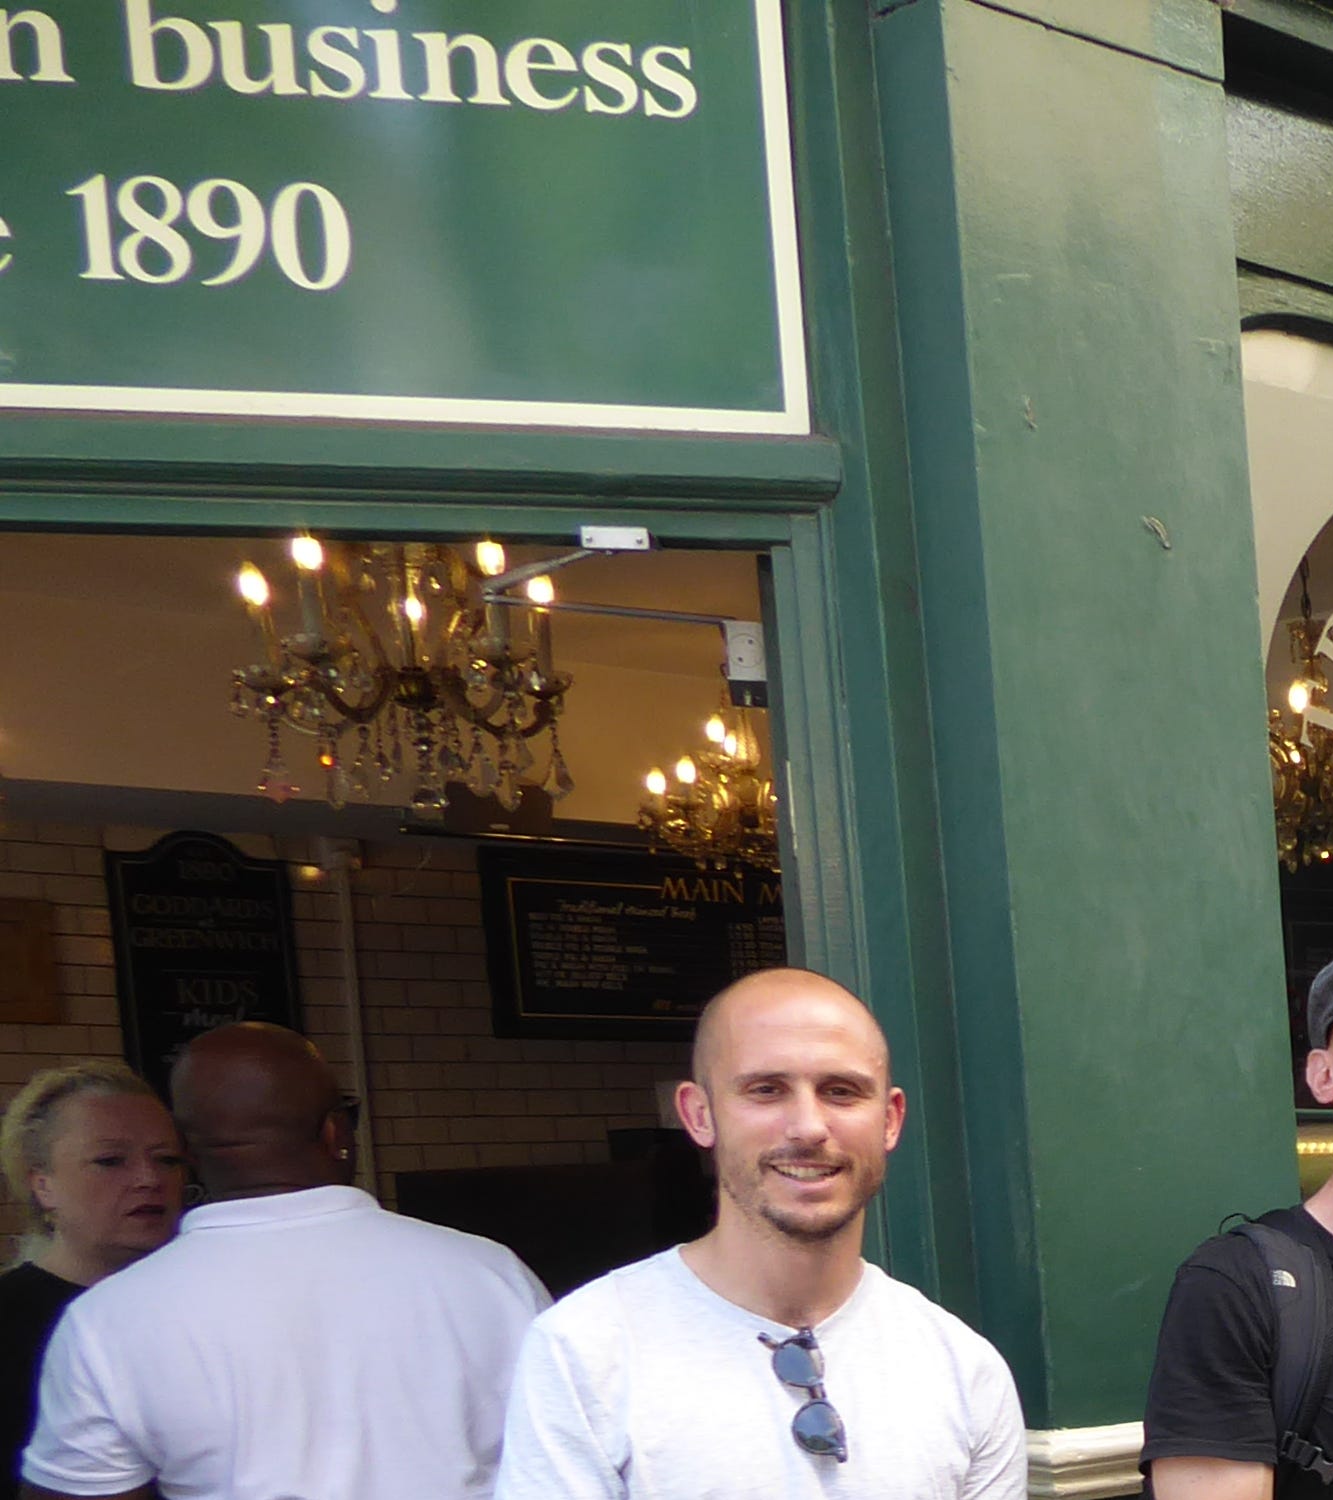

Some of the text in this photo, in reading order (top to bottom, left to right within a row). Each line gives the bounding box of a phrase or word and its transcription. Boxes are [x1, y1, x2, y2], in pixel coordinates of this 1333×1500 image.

[125, 0, 699, 119] business
[65, 173, 352, 291] 1890
[660, 876, 745, 904] MAIN
[176, 977, 260, 1008] KIDS
